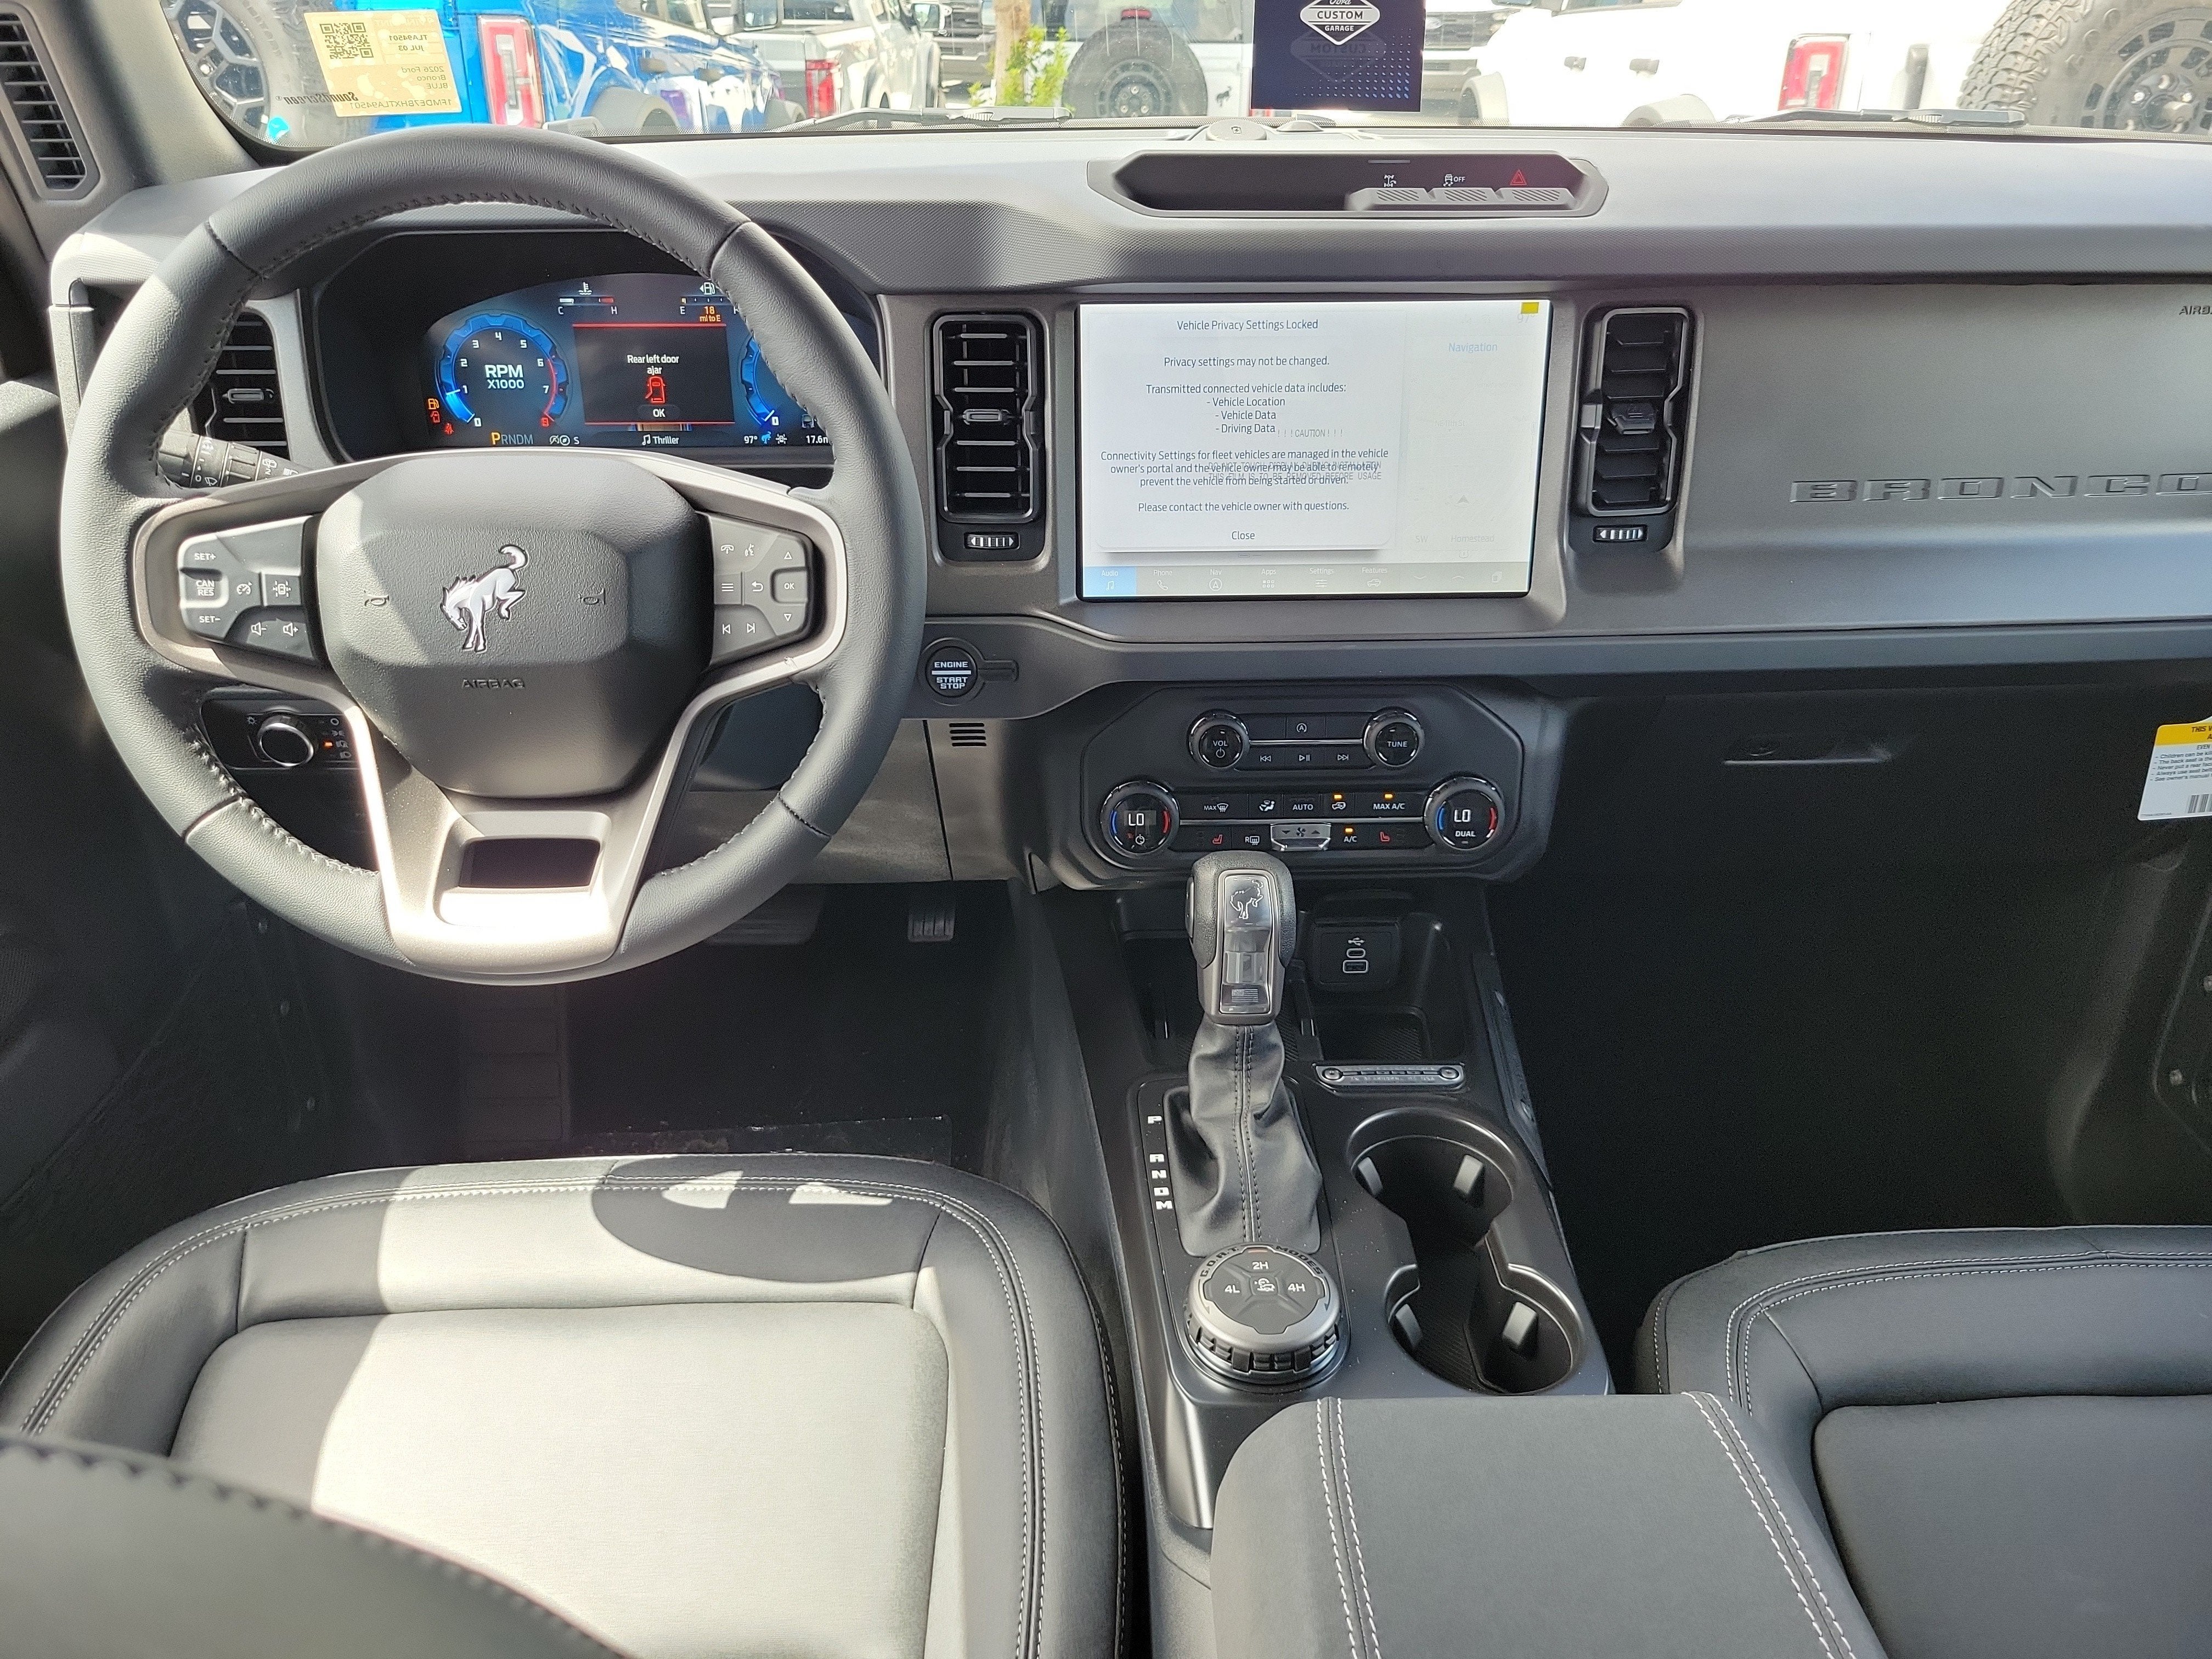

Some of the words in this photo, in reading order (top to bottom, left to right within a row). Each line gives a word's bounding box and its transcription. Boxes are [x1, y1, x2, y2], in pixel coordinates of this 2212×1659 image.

[1317, 10, 1363, 20] CUSTOM
[558, 306, 564, 315] C
[611, 306, 618, 315] H
[680, 306, 686, 315] E
[704, 306, 715, 314] 18
[1177, 320, 1210, 330] Vehicle
[1211, 320, 1244, 331] Privacy
[1246, 320, 1284, 331] Settings
[1286, 319, 1318, 329] Locked
[495, 331, 503, 341] 4
[472, 340, 479, 348] 3
[520, 340, 528, 348] 5
[1448, 342, 1498, 354] Navigation
[460, 358, 468, 367] 2
[537, 358, 544, 367] 6
[627, 355, 646, 364] Rear
[646, 354, 661, 364] left
[661, 354, 680, 364] door
[1164, 357, 1197, 368] Privacy
[1198, 357, 1235, 368] settings
[1237, 358, 1256, 368] may
[1258, 357, 1274, 366] not
[1276, 356, 1287, 366] be
[1289, 356, 1329, 367] changed.
[484, 364, 524, 378] RPM
[646, 366, 663, 376] ajar
[462, 385, 469, 394] 1
[487, 380, 524, 389] X1000
[543, 385, 550, 394] 7
[1146, 383, 1201, 394] Transmitted
[1203, 383, 1250, 393] connected
[1251, 383, 1283, 393] vehicle
[1284, 383, 1305, 393] data
[1307, 382, 1346, 392] includes:
[1212, 397, 1244, 407] Vehicle
[1246, 397, 1285, 407] Location
[652, 408, 666, 418] OK
[1221, 410, 1253, 420] Vehicle
[1255, 410, 1277, 420] Data
[474, 417, 482, 427] 0
[771, 416, 779, 426] 0
[1221, 424, 1252, 435] Driving
[1254, 424, 1276, 433] Data
[1295, 429, 1325, 437] CAUTION
[652, 436, 679, 444] Thriller
[1101, 451, 1156, 462] Connectivity
[1159, 450, 1195, 461] Settings
[1197, 450, 1210, 460] for
[1212, 450, 1233, 459] fleet
[1234, 449, 1269, 459] vehicles
[1287, 449, 1329, 460] managed
[1331, 449, 1339, 458] in
[1341, 448, 1356, 458] the
[1357, 448, 1389, 458] vehicle
[1110, 464, 1144, 473] owner's
[1147, 463, 1173, 475] portal
[1175, 463, 1192, 473] and
[1194, 463, 1209, 473] the
[1211, 463, 1242, 472] vehicle
[1273, 465, 1292, 473] may
[1294, 462, 1305, 472] be
[1306, 462, 1325, 471] able
[1338, 462, 1378, 473] remotely
[1140, 477, 1174, 488] prevent
[1176, 476, 1191, 486] the
[1193, 476, 1223, 486] vehicle
[1224, 476, 1246, 485] from
[1248, 476, 1272, 487] being
[1274, 476, 1306, 485] started
[1318, 475, 1349, 484] driven.
[1790, 472, 2212, 503] BRONCO
[1138, 503, 1167, 512] Please
[1169, 503, 1203, 511] contact
[1205, 502, 1220, 511] the
[1221, 501, 1252, 511] vehicle
[1283, 501, 1302, 511] with
[1304, 501, 1349, 512] questions.
[1232, 531, 1255, 540] Close
[194, 552, 217, 561] SET+
[196, 579, 215, 588] CAN
[783, 582, 795, 591] OK
[197, 588, 215, 596] RES
[461, 678, 526, 690] AIRBAG
[1391, 802, 1406, 810] A/C
[1128, 813, 1144, 826] LO
[1454, 809, 1471, 822] LO
[1343, 835, 1358, 843] A/C
[1148, 1115, 1163, 1125] P
[1149, 1154, 1164, 1163] R
[1152, 1170, 1167, 1179] N
[1153, 1187, 1170, 1197] D
[1156, 1200, 1173, 1210] M
[1276, 1245, 1324, 1275] MODES
[1252, 1261, 1269, 1270] 2H
[1224, 1284, 1240, 1294] 4L
[1288, 1283, 1306, 1293] 4H
